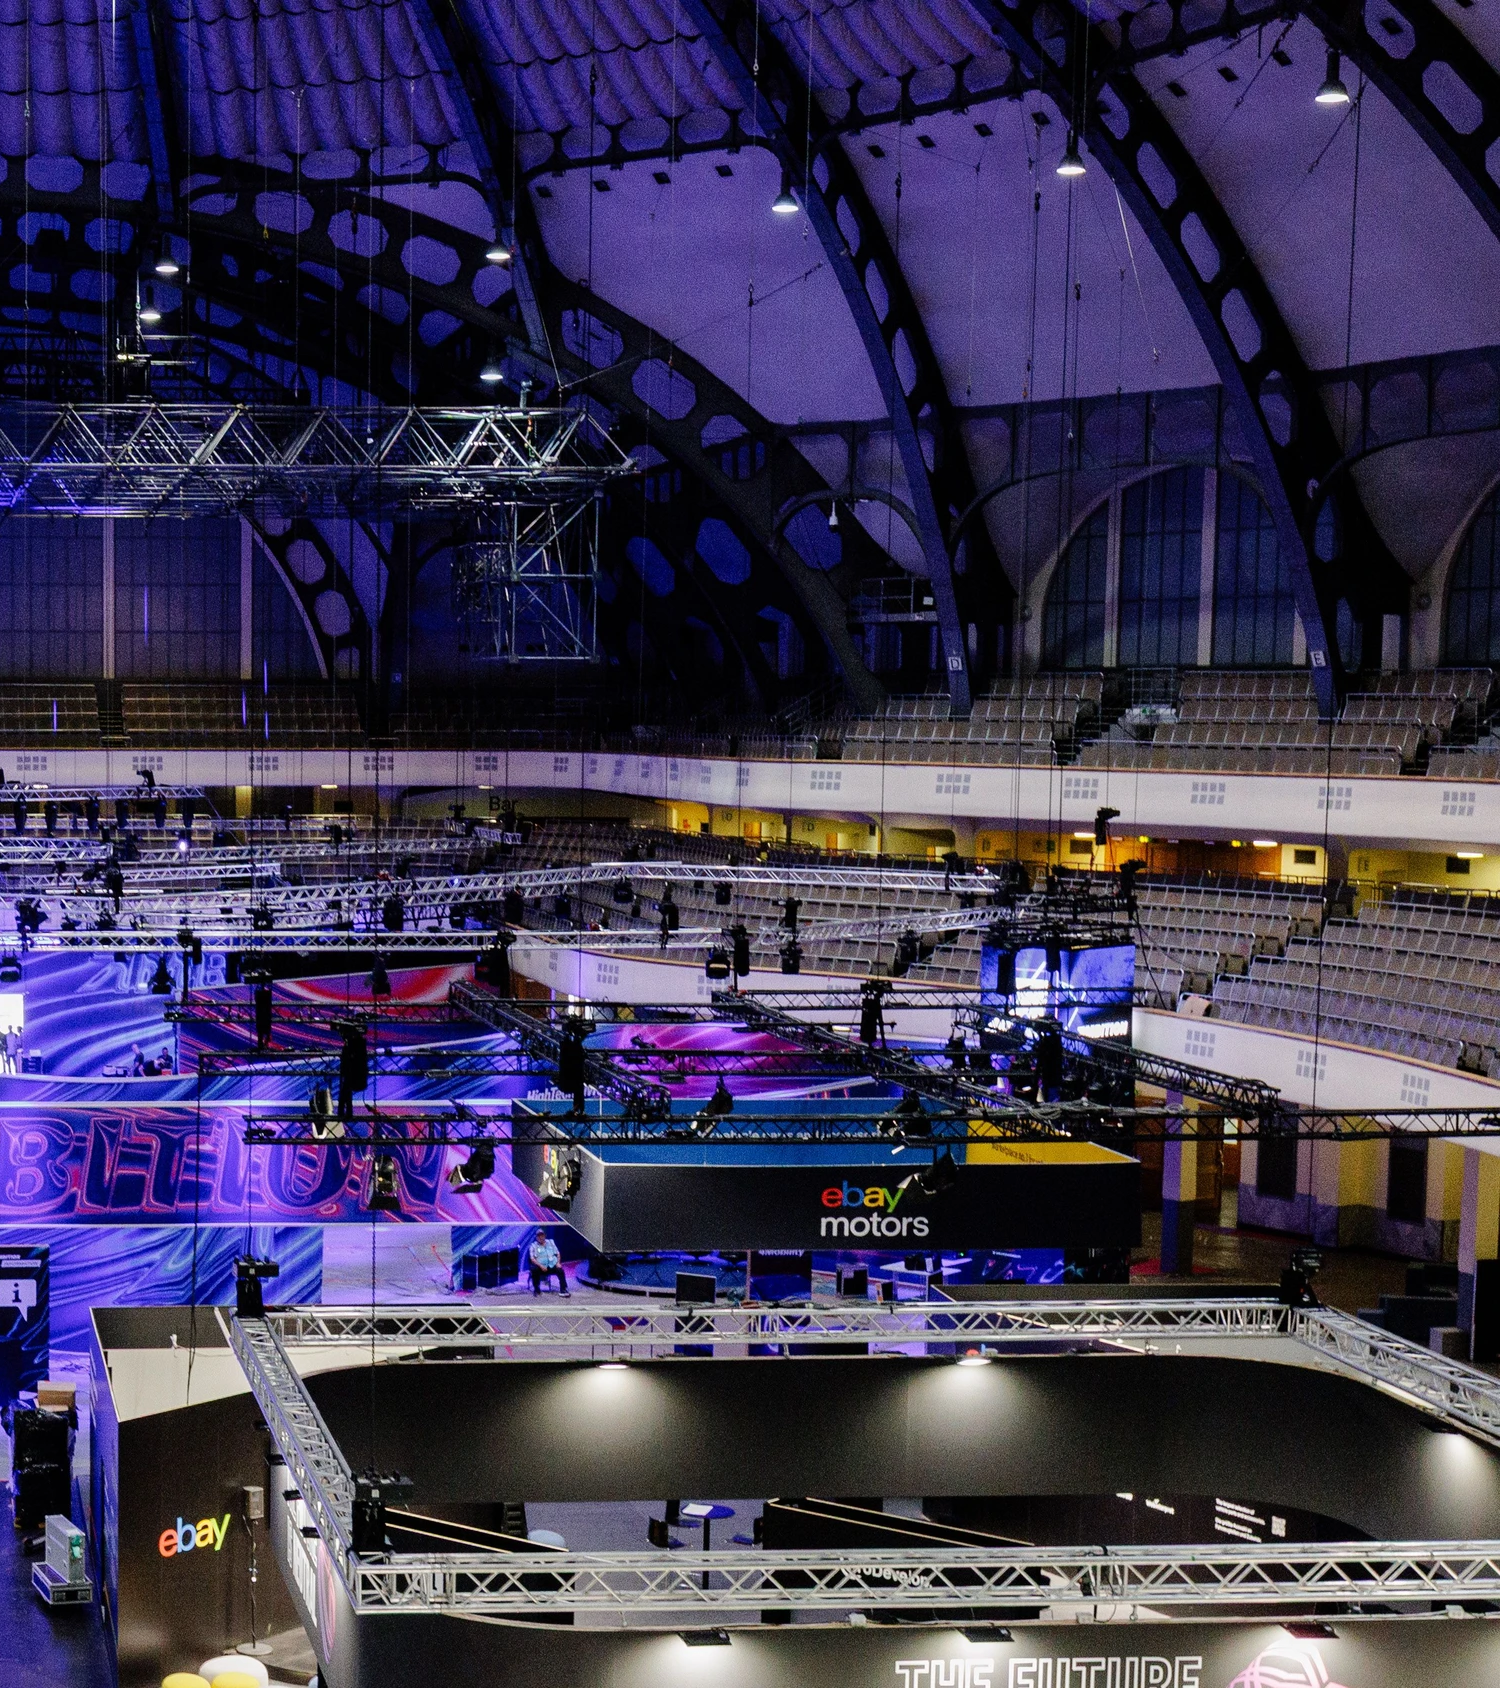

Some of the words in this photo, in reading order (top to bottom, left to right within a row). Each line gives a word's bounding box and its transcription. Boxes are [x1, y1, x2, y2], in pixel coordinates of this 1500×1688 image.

[821, 1180, 904, 1213] ebay
[820, 1211, 930, 1237] motors
[158, 1513, 231, 1558] ebay
[895, 1658, 995, 1688] THE
[1008, 1656, 1202, 1688] FUTURE
